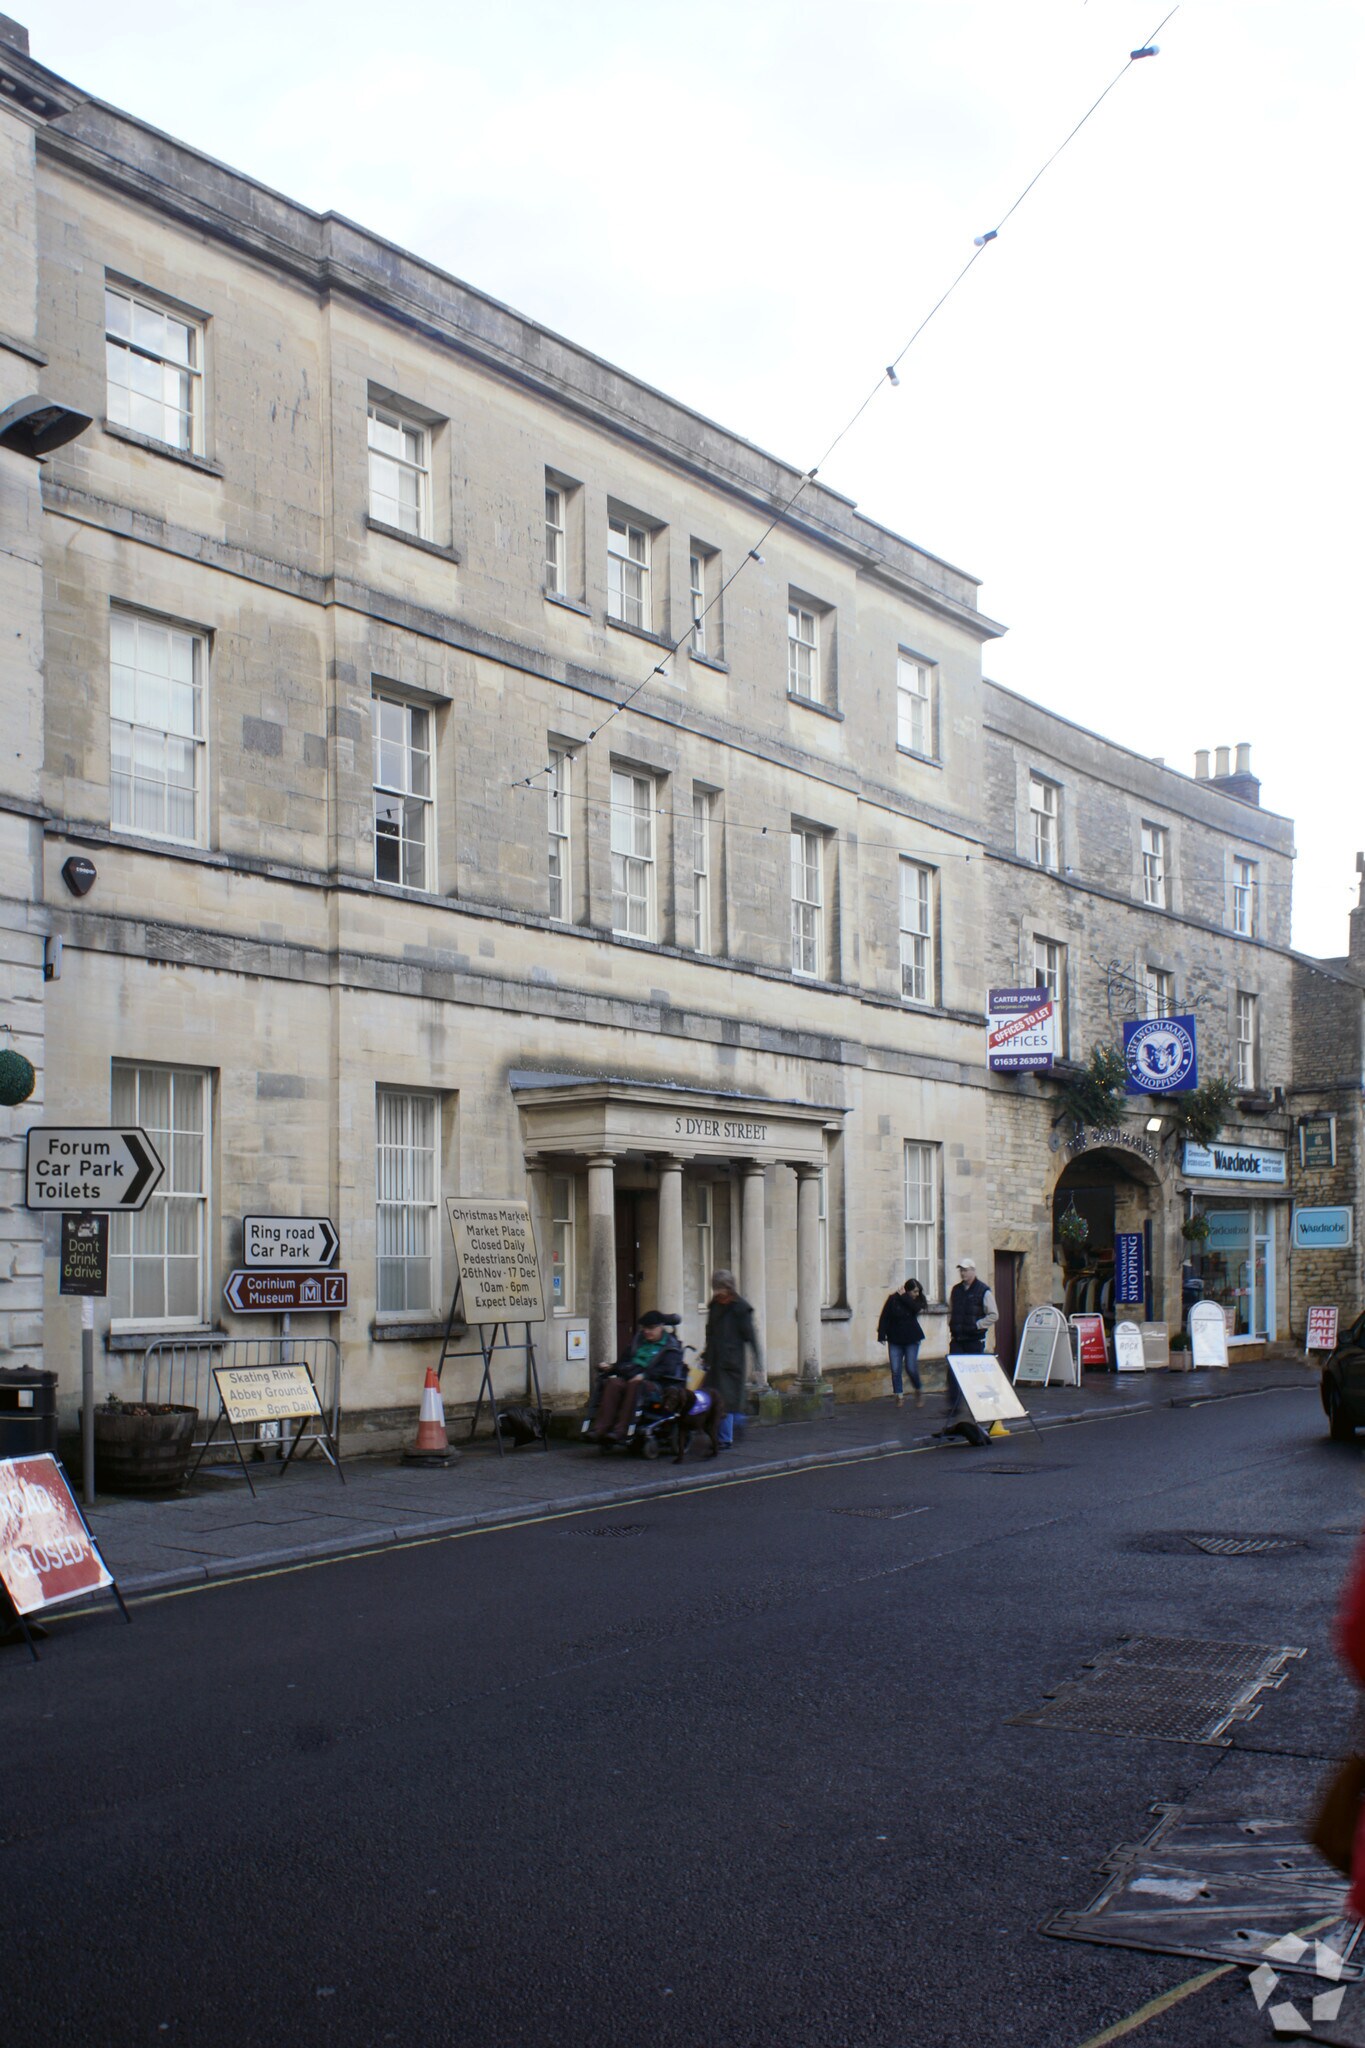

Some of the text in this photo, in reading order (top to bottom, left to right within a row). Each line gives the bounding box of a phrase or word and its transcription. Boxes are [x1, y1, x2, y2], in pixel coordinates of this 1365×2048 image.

[1018, 995, 1041, 1004] JONAS
[994, 1020, 1025, 1042] OFFICES
[1024, 1015, 1035, 1026] TO
[1034, 1006, 1050, 1020] LET
[1128, 1022, 1191, 1058] THE WOOLMARKET
[994, 1056, 1048, 1066] 01635 263030
[1137, 1068, 1184, 1088] SHOPPING
[675, 1117, 767, 1140] 5 DYER STREET
[48, 1139, 110, 1155] Forum
[36, 1160, 124, 1177] Car Park
[35, 1181, 100, 1199] Toilets
[452, 1209, 529, 1221] Christmas Market
[250, 1225, 315, 1241] Ring road
[466, 1225, 525, 1237] Market Place
[68, 1239, 100, 1253] Don't
[250, 1243, 310, 1258] Car Park
[471, 1239, 525, 1252] Closed Daily
[69, 1252, 98, 1266] drink
[463, 1253, 538, 1266] Pedestrians Only
[64, 1264, 102, 1279] & drive
[508, 1267, 517, 1278] 17
[520, 1268, 536, 1278] Dec
[1128, 1236, 1139, 1301] SHOPPING
[247, 1278, 296, 1290] Corinium
[480, 1281, 504, 1293] 10am
[510, 1282, 529, 1295] 6pm
[249, 1292, 294, 1304] Museum
[475, 1295, 538, 1309] Expect Delays
[1310, 1309, 1335, 1318] SALE
[1310, 1318, 1335, 1327] SALE
[229, 1369, 296, 1384] Skating Rink
[229, 1385, 309, 1401] Abbey Grounds
[229, 1406, 258, 1419] 12pm
[267, 1403, 290, 1417] 8pm
[292, 1400, 317, 1413] Daily
[0, 1483, 53, 1518] ROAD
[7, 1534, 86, 1579] CLOSED
